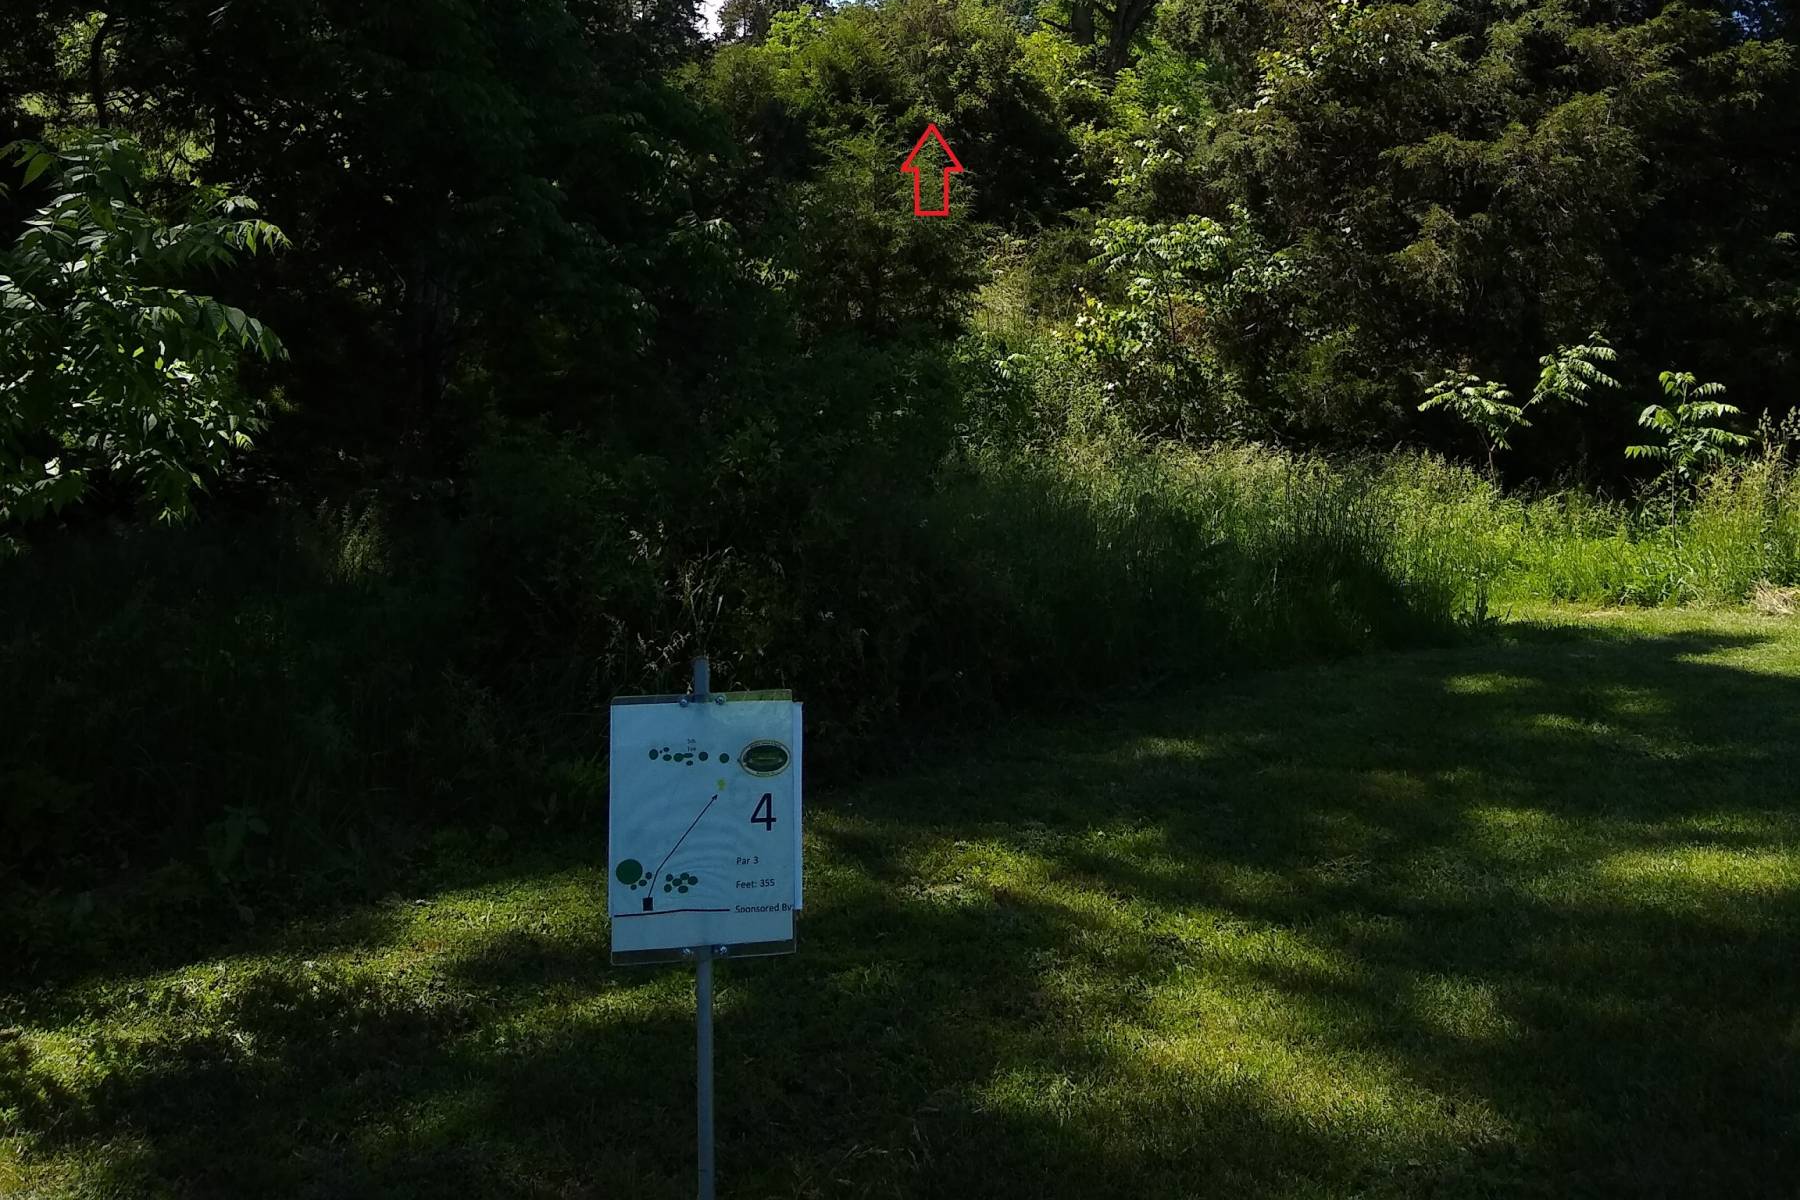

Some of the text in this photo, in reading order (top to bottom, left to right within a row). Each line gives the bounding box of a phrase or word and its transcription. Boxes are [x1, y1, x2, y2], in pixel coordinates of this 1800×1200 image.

[751, 793, 776, 831] 4
[736, 856, 759, 865] Par 3
[736, 879, 775, 889] Feet: 355
[735, 904, 780, 913] Sponsored
